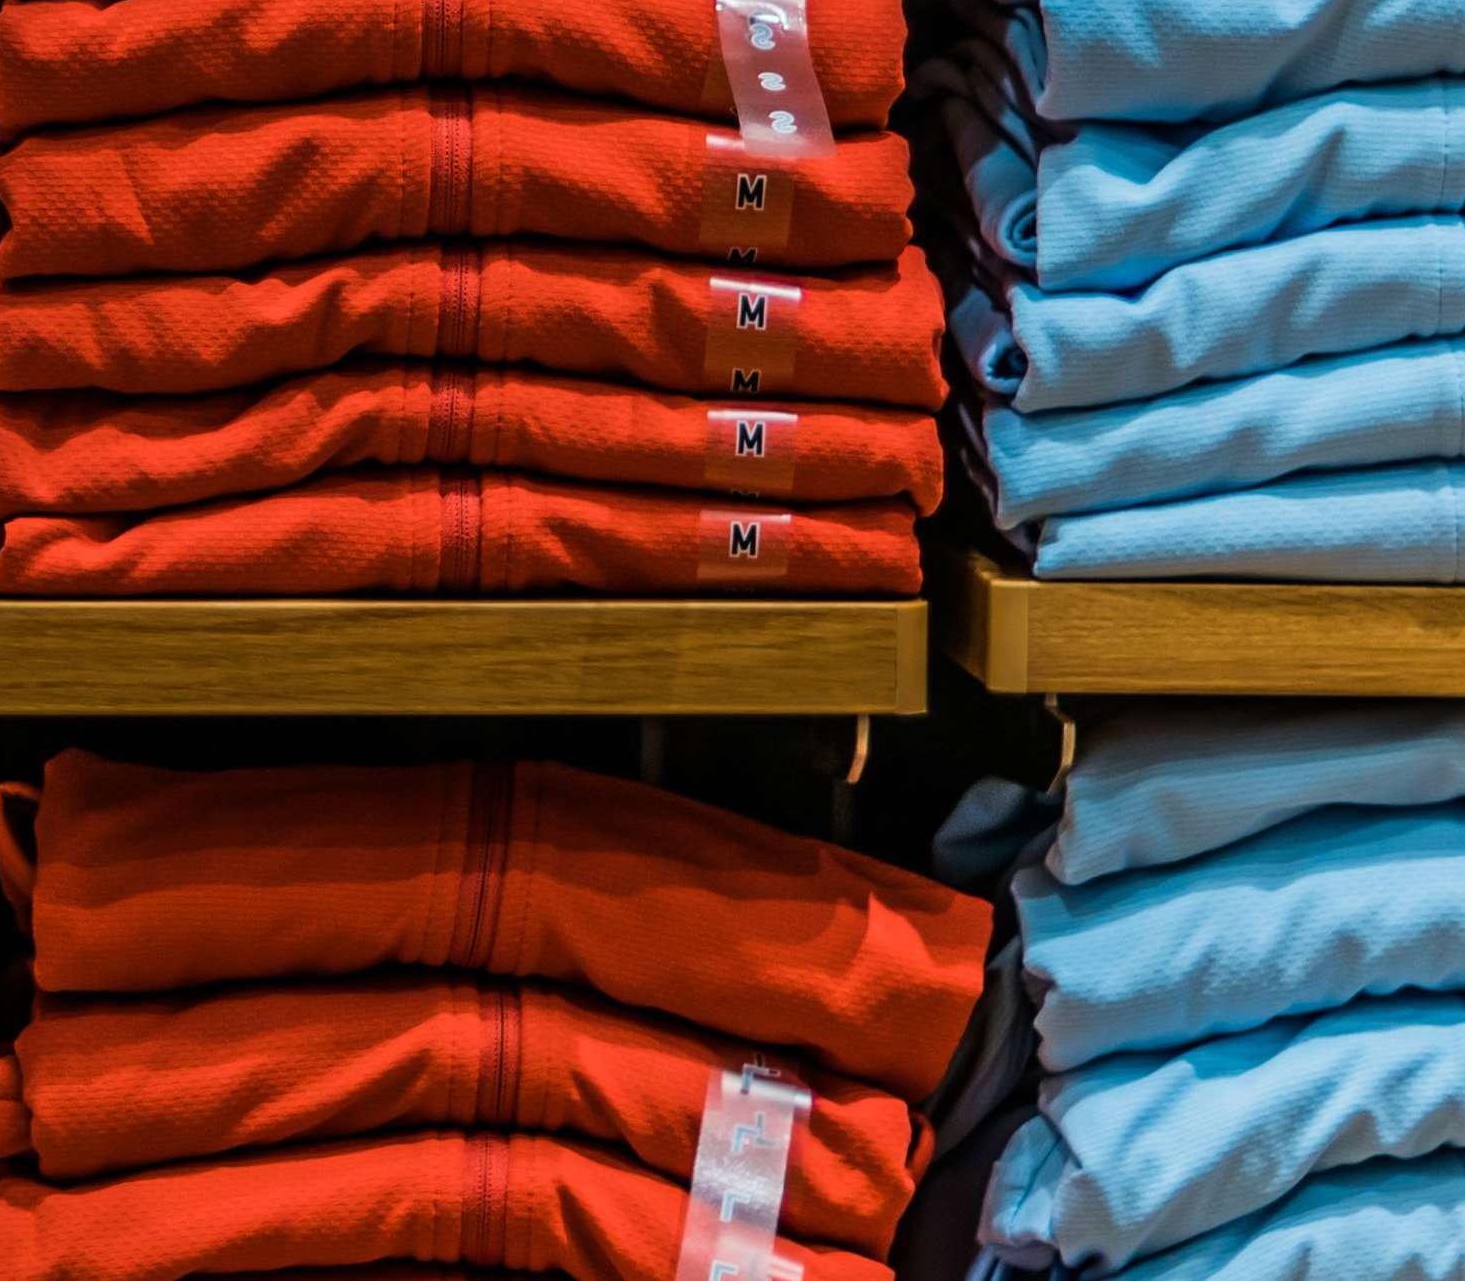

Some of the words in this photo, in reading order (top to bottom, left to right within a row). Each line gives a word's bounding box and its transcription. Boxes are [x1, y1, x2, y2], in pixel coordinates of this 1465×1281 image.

[736, 174, 767, 210] M
[738, 294, 767, 329] M
[732, 370, 760, 393] M
[736, 421, 765, 457] M
[730, 522, 760, 558] M
